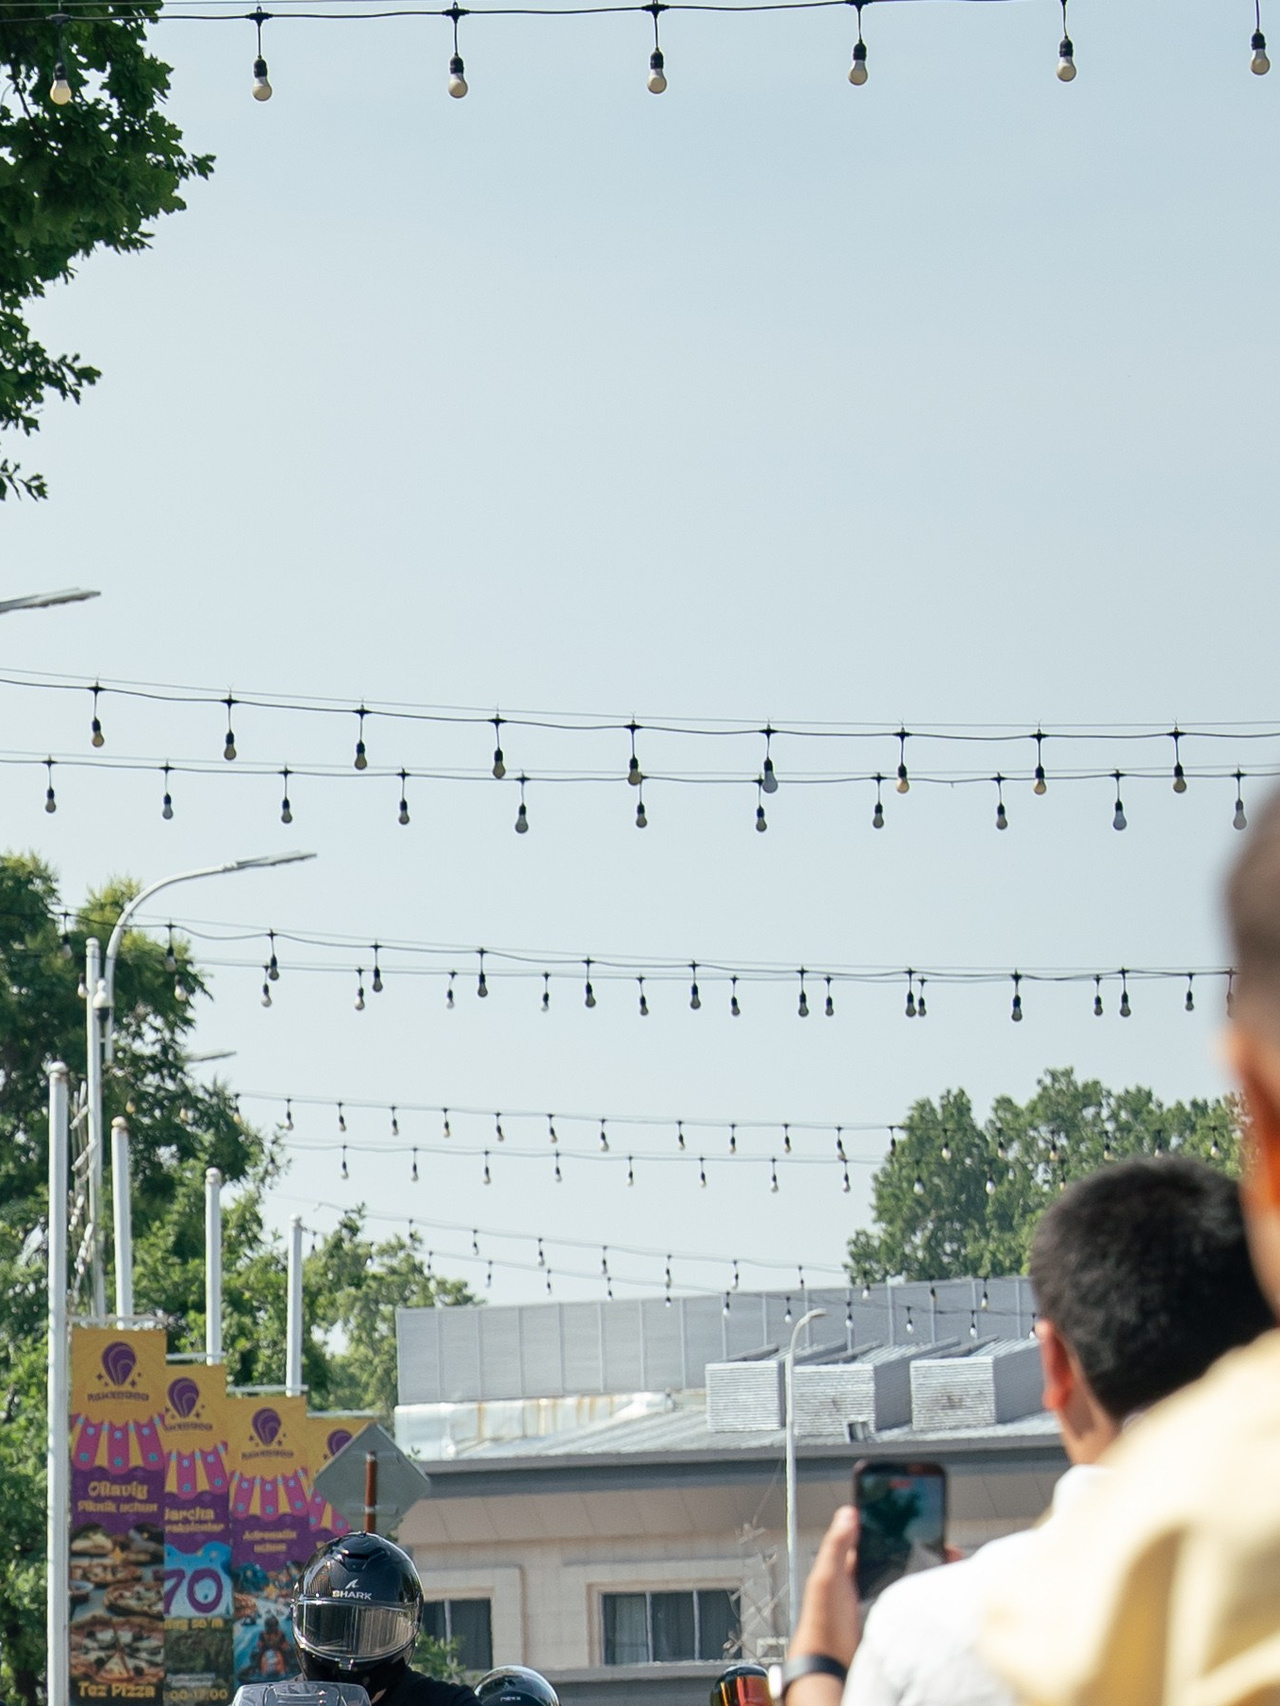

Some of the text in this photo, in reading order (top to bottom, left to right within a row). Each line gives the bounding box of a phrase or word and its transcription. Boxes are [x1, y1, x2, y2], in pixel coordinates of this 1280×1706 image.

[331, 1590, 372, 1600] SHARK
[78, 1681, 156, 1698] Tez Pizza
